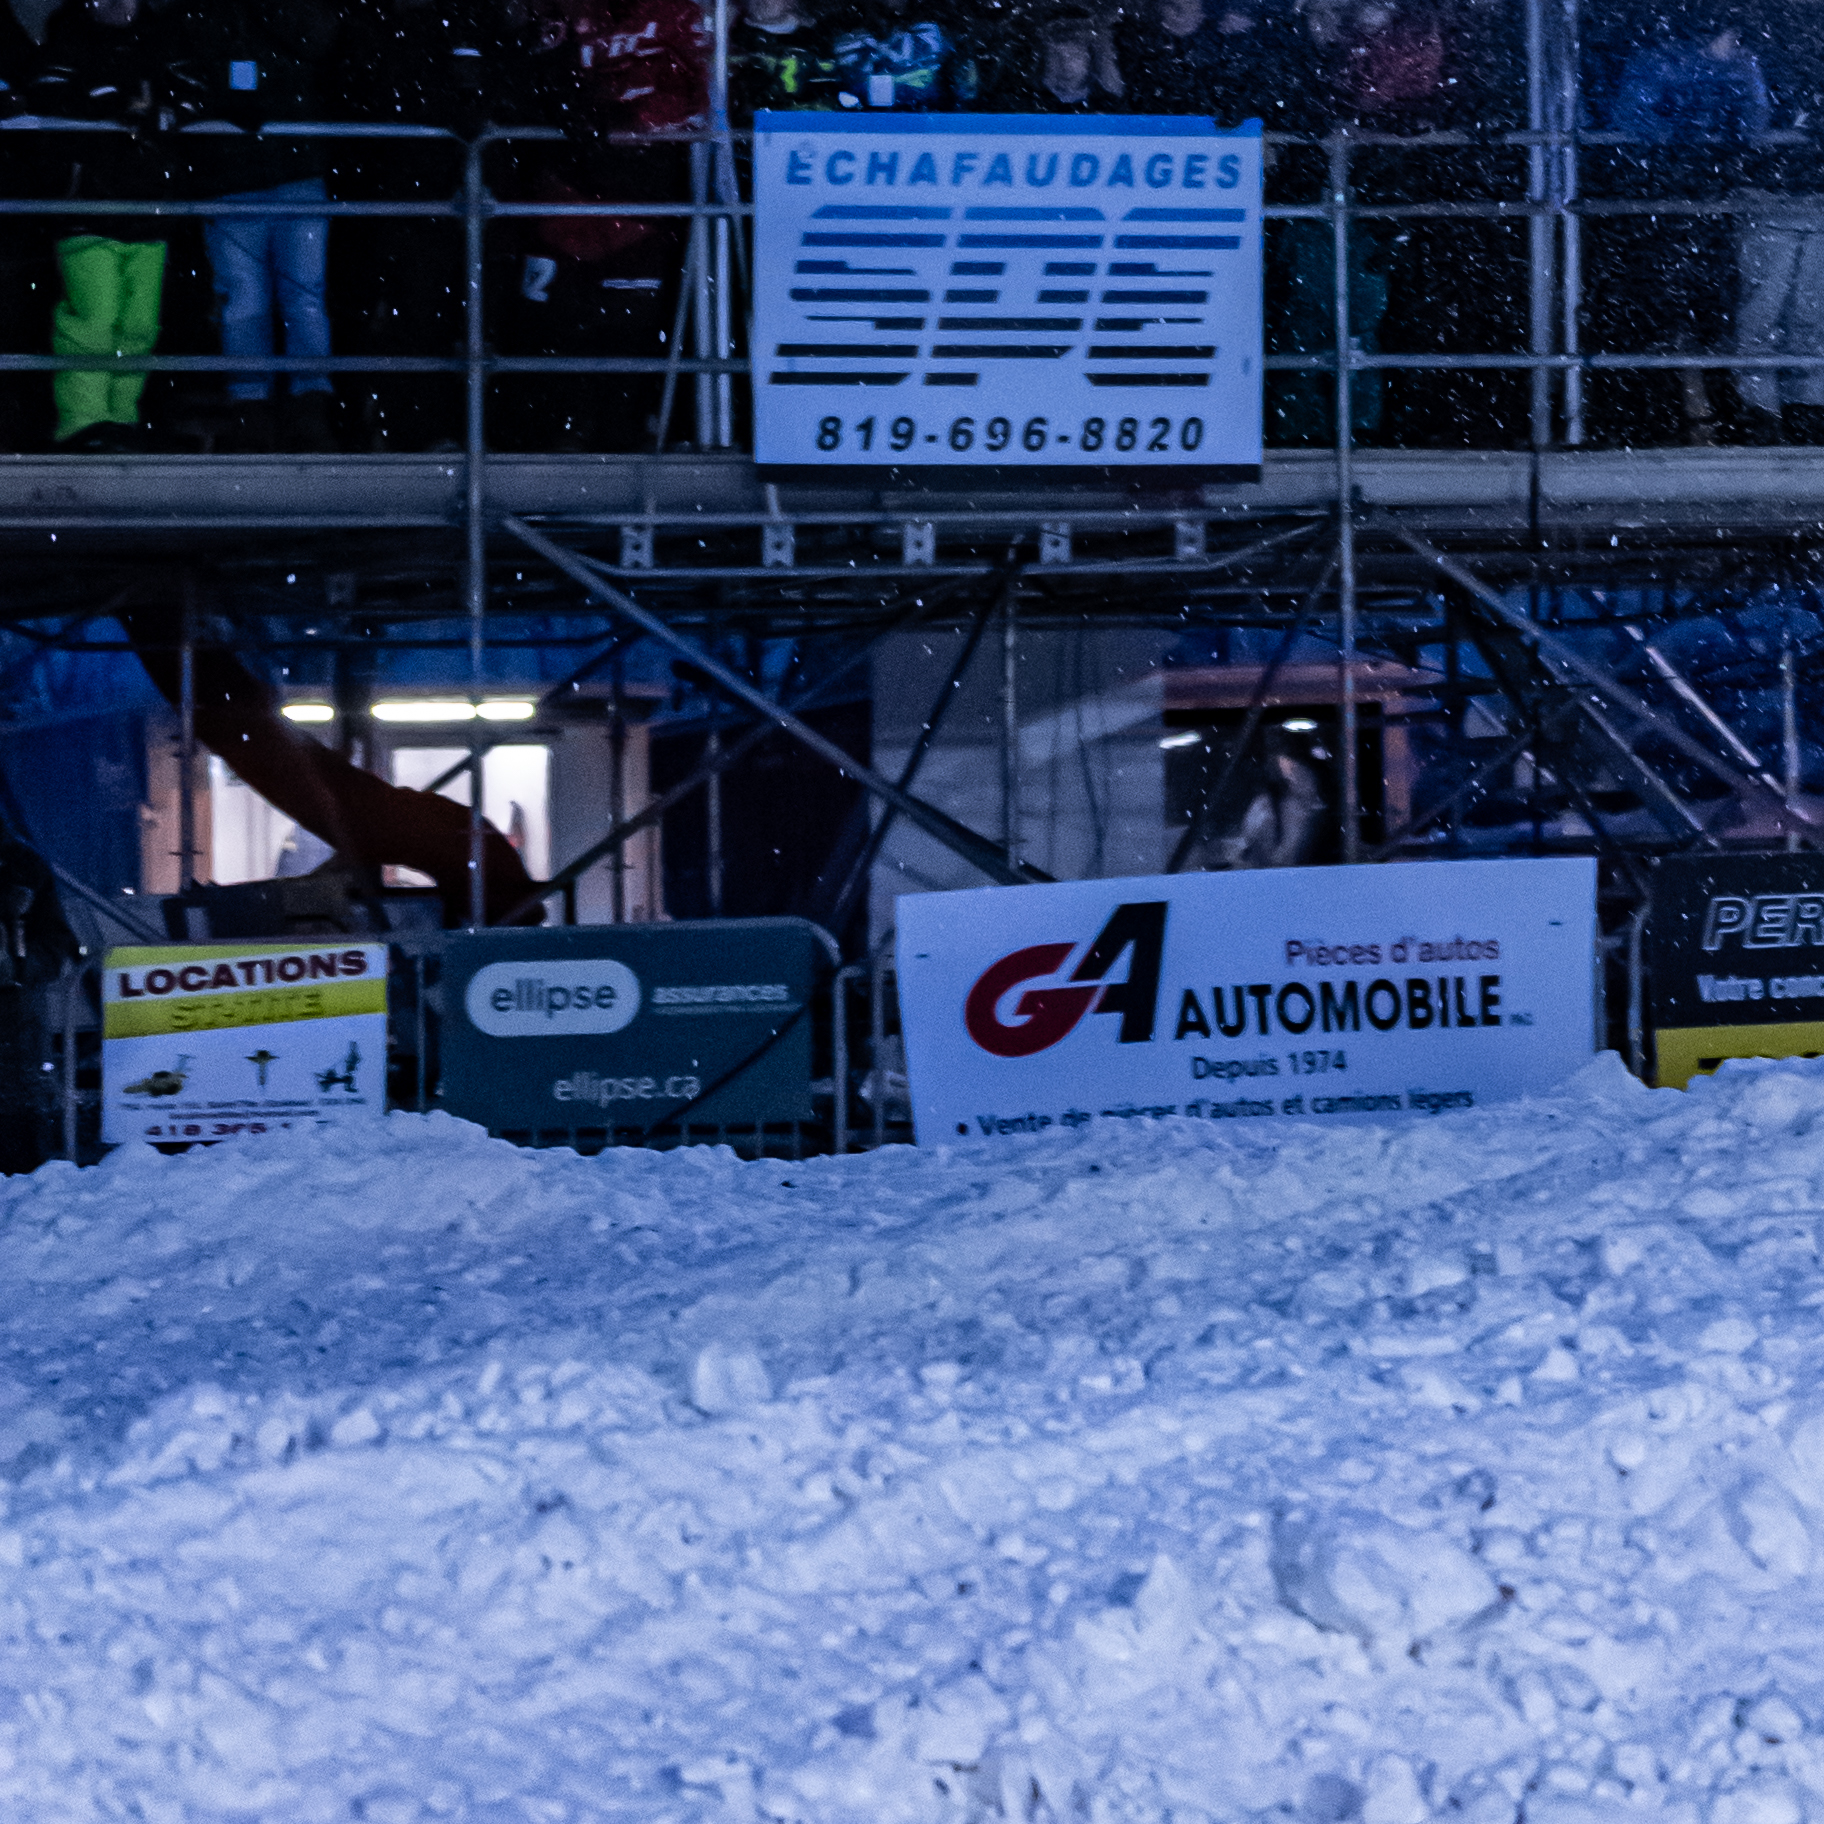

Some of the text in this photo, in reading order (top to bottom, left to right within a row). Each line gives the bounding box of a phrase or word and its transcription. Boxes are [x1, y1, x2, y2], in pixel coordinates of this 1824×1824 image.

[814, 414, 1206, 453] 819-696-8820
[1285, 935, 1500, 967] Pièces d'autos
[120, 950, 368, 998] LOCATIONS
[490, 977, 618, 1019] ellipse
[1174, 974, 1502, 1042] AUTOMOBILE
[1191, 1049, 1348, 1083] Depuis 1974
[552, 1070, 702, 1108] ellipse.ca
[978, 1113, 1053, 1136] Vente
